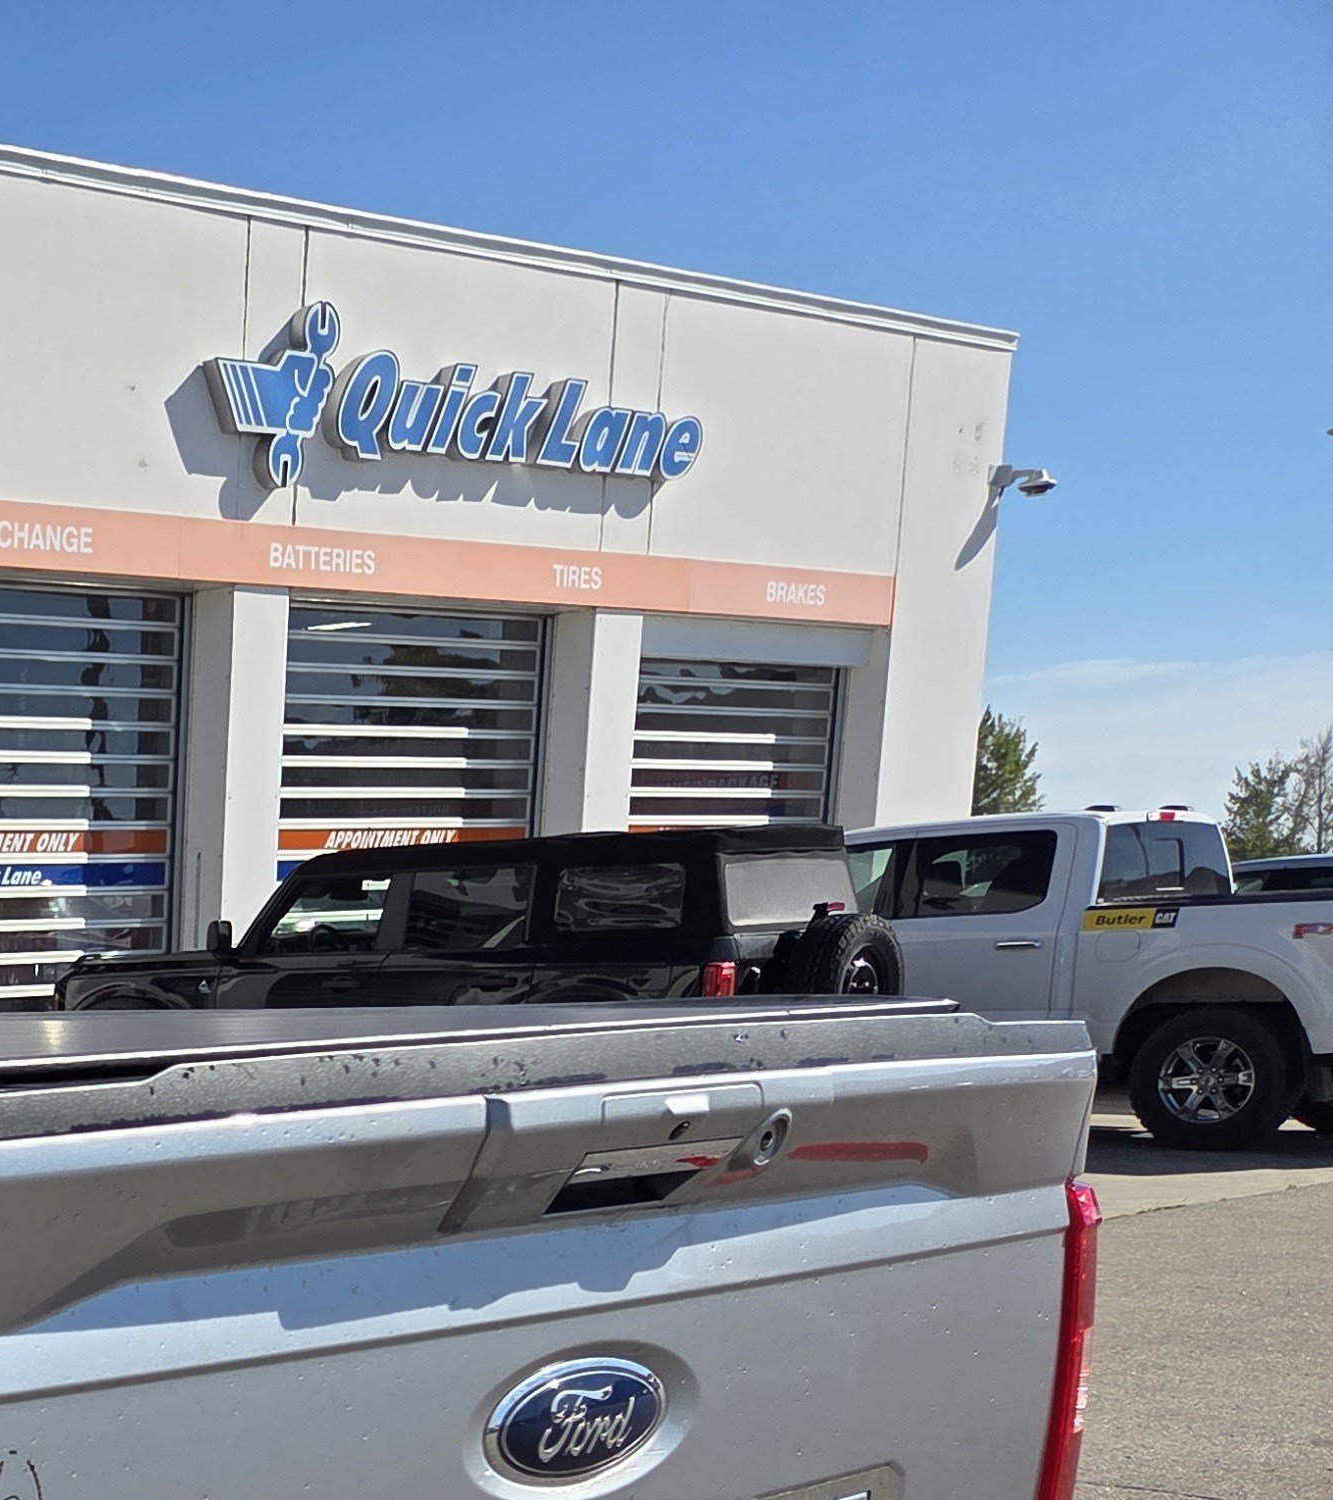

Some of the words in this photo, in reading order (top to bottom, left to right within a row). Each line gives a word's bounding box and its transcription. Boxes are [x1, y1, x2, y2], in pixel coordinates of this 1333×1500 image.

[337, 350, 548, 464] Quick
[536, 378, 703, 480] Lane
[269, 541, 375, 576] BATTERIES
[552, 564, 602, 591] TIRES
[766, 581, 826, 606] BRAKES
[36, 833, 80, 852] ONLY
[324, 829, 419, 849] APPOINTMENT
[420, 829, 457, 844] ONLY
[1, 866, 42, 886] Lane
[1094, 914, 1147, 926] Butler
[1155, 912, 1176, 924] CAT
[538, 1385, 635, 1463] Ford
